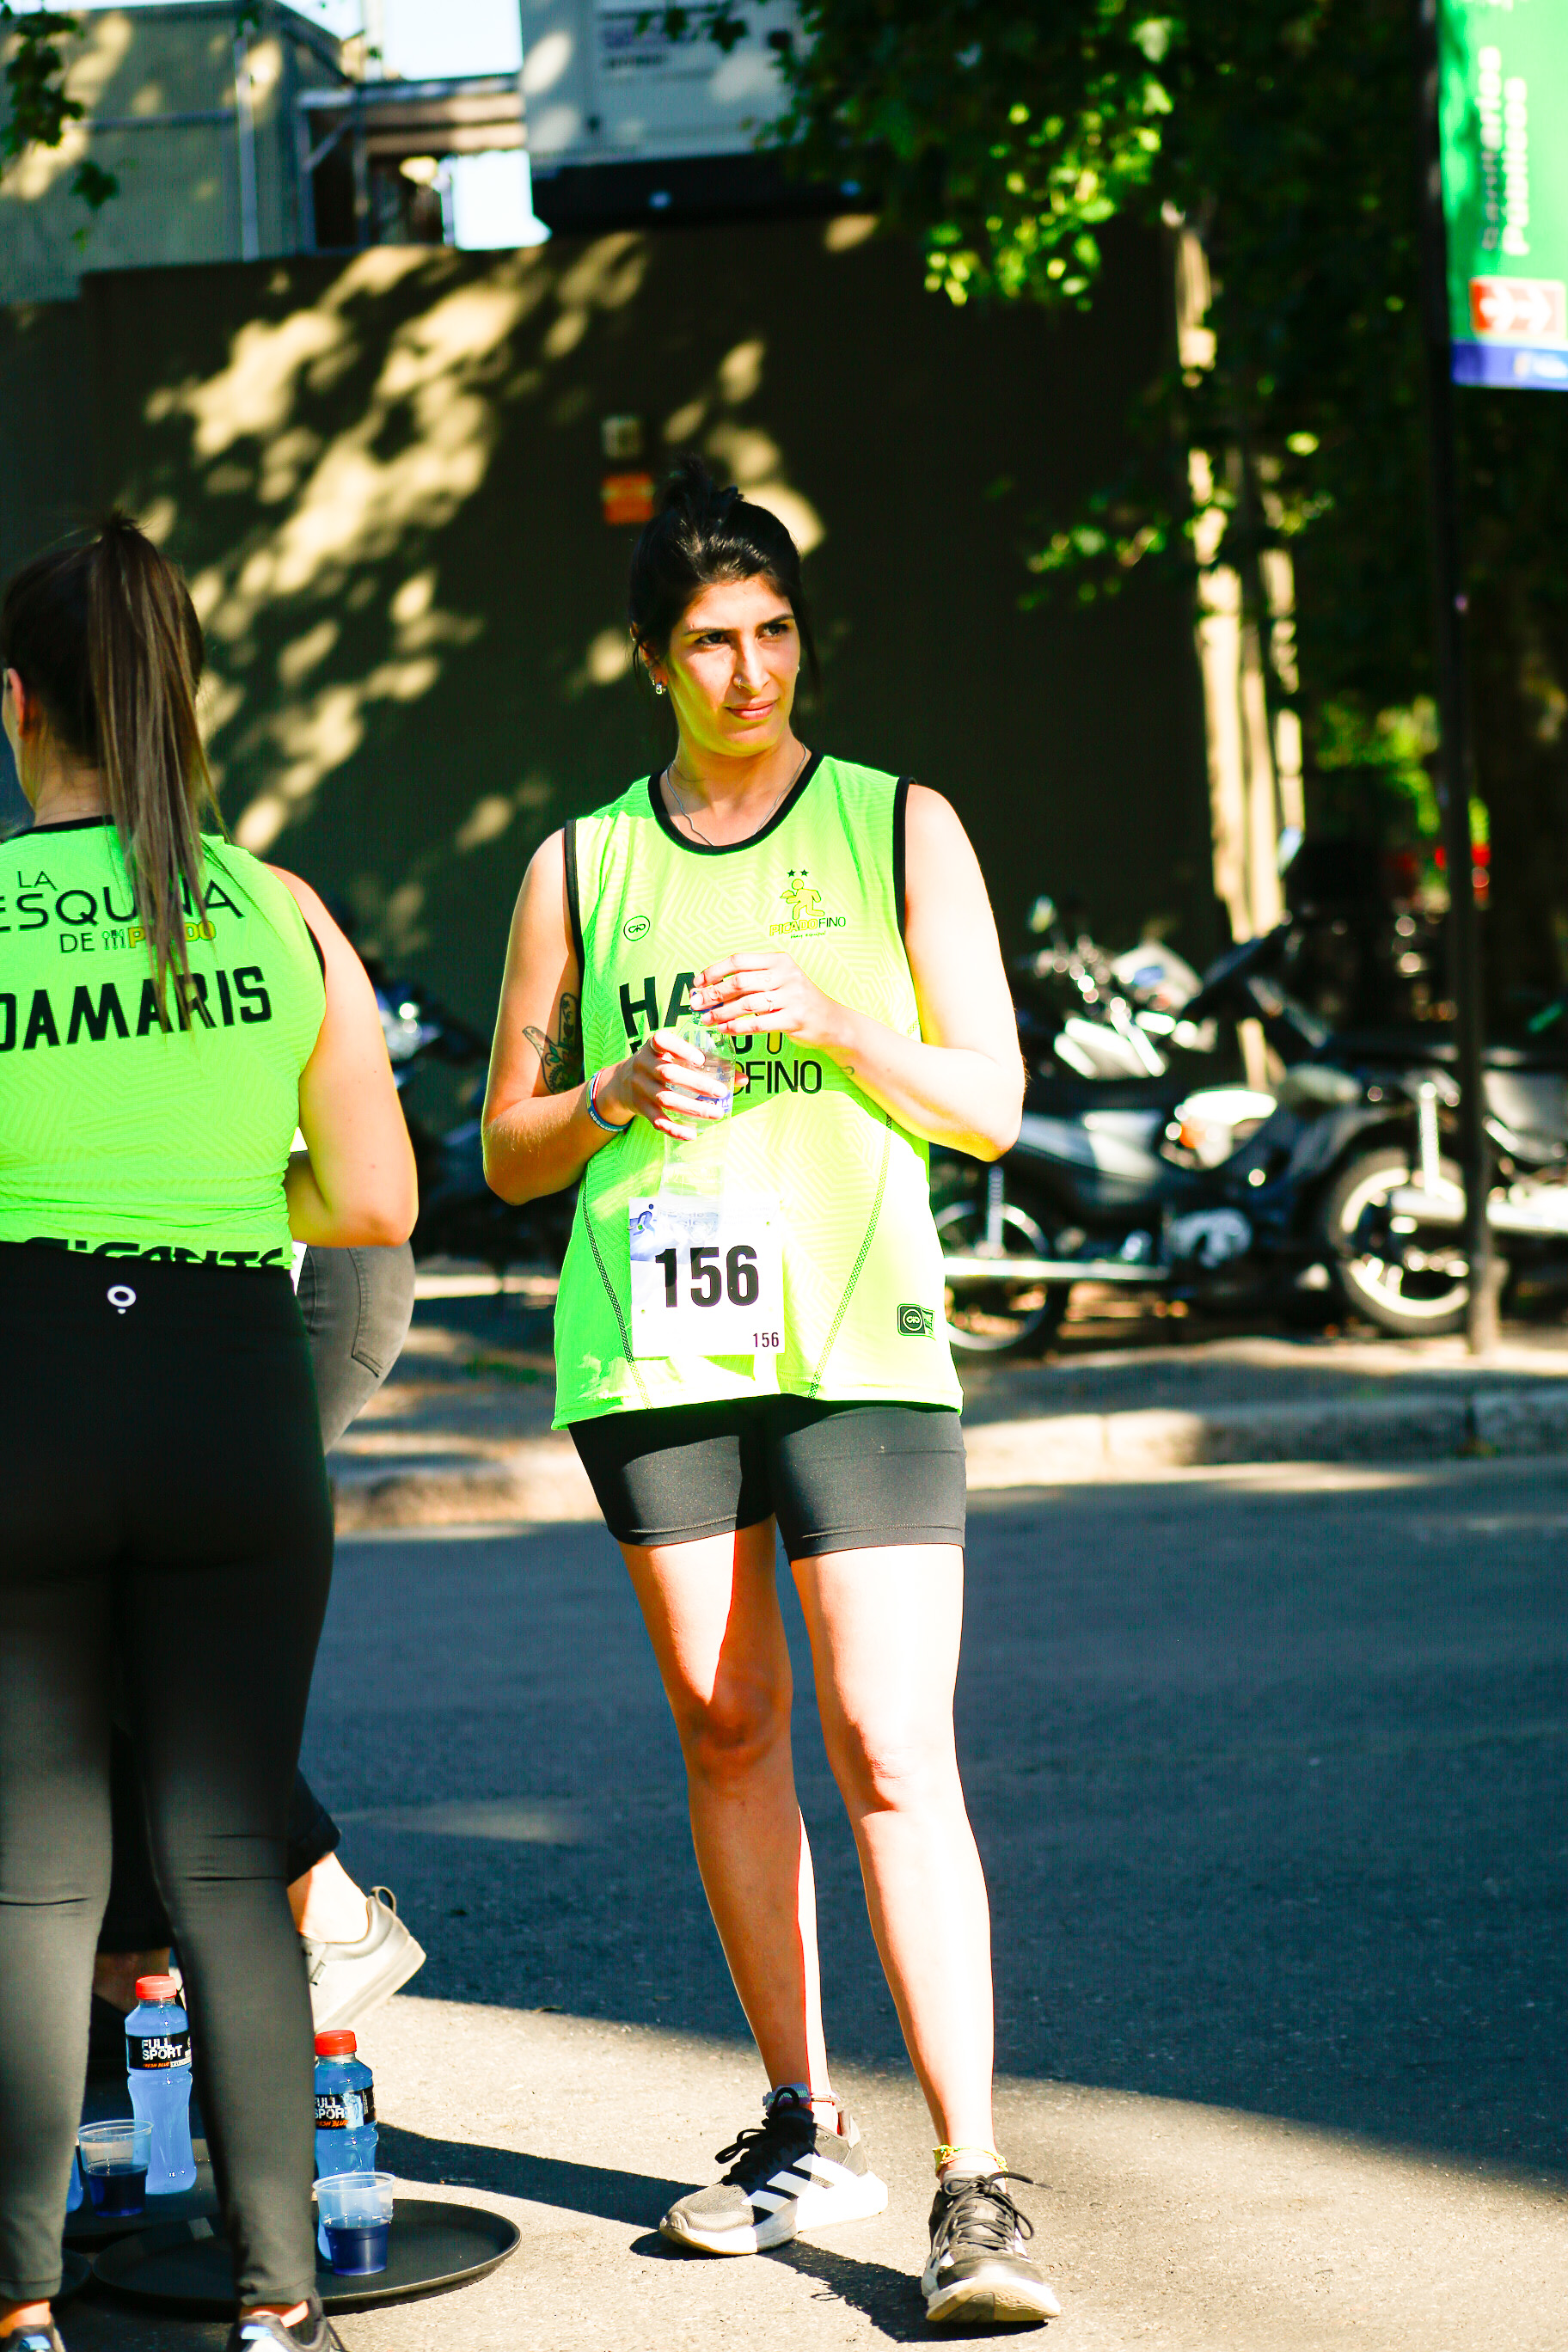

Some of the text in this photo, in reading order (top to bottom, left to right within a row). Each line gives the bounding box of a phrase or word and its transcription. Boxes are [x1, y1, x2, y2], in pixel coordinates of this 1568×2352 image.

[17, 870, 58, 891] LA
[59, 933, 95, 953] DE
[654, 1245, 760, 1308] 156
[752, 1332, 780, 1348] 156
[142, 2037, 173, 2050] FULL
[142, 2044, 183, 2061] SPORT
